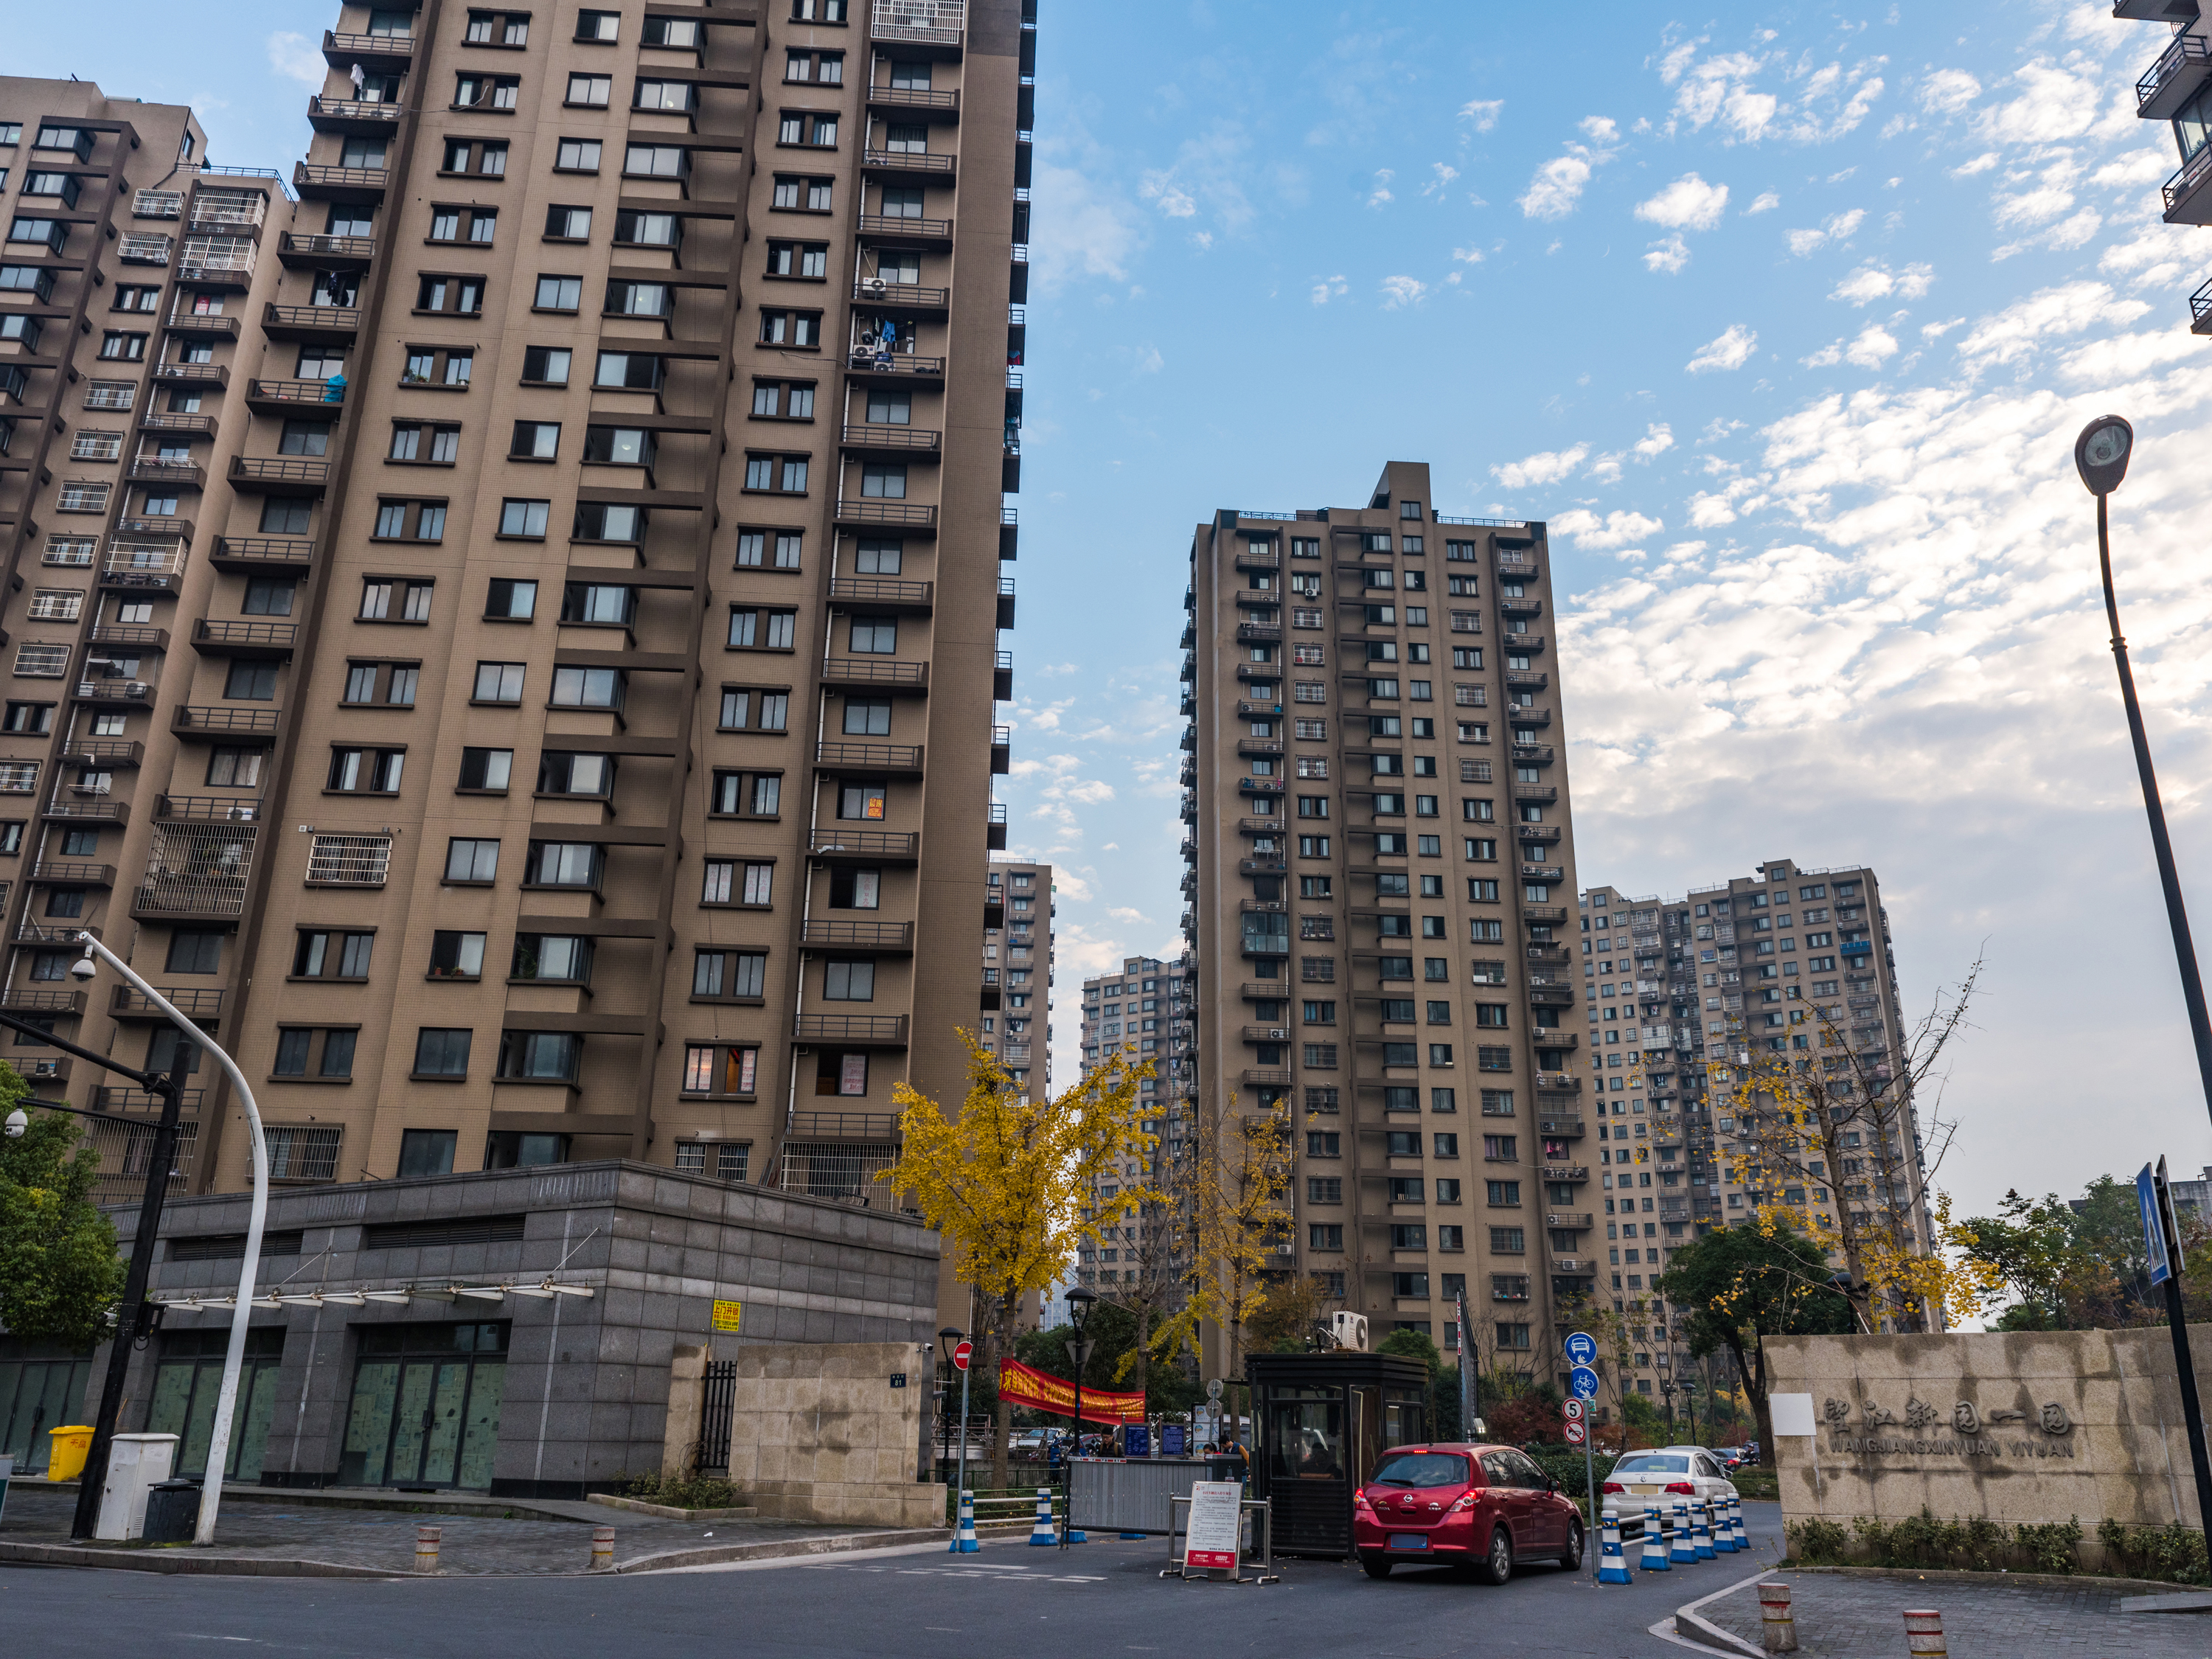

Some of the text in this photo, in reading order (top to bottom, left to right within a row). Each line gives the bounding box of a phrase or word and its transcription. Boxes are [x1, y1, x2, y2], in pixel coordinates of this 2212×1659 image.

[714, 1305, 739, 1316] 上门开锁
[1569, 1403, 1577, 1417] 5
[1823, 1398, 2069, 1436] 望江新园一园
[1829, 1438, 2074, 1458] WANGJIANGXINYUAN YIYUAN
